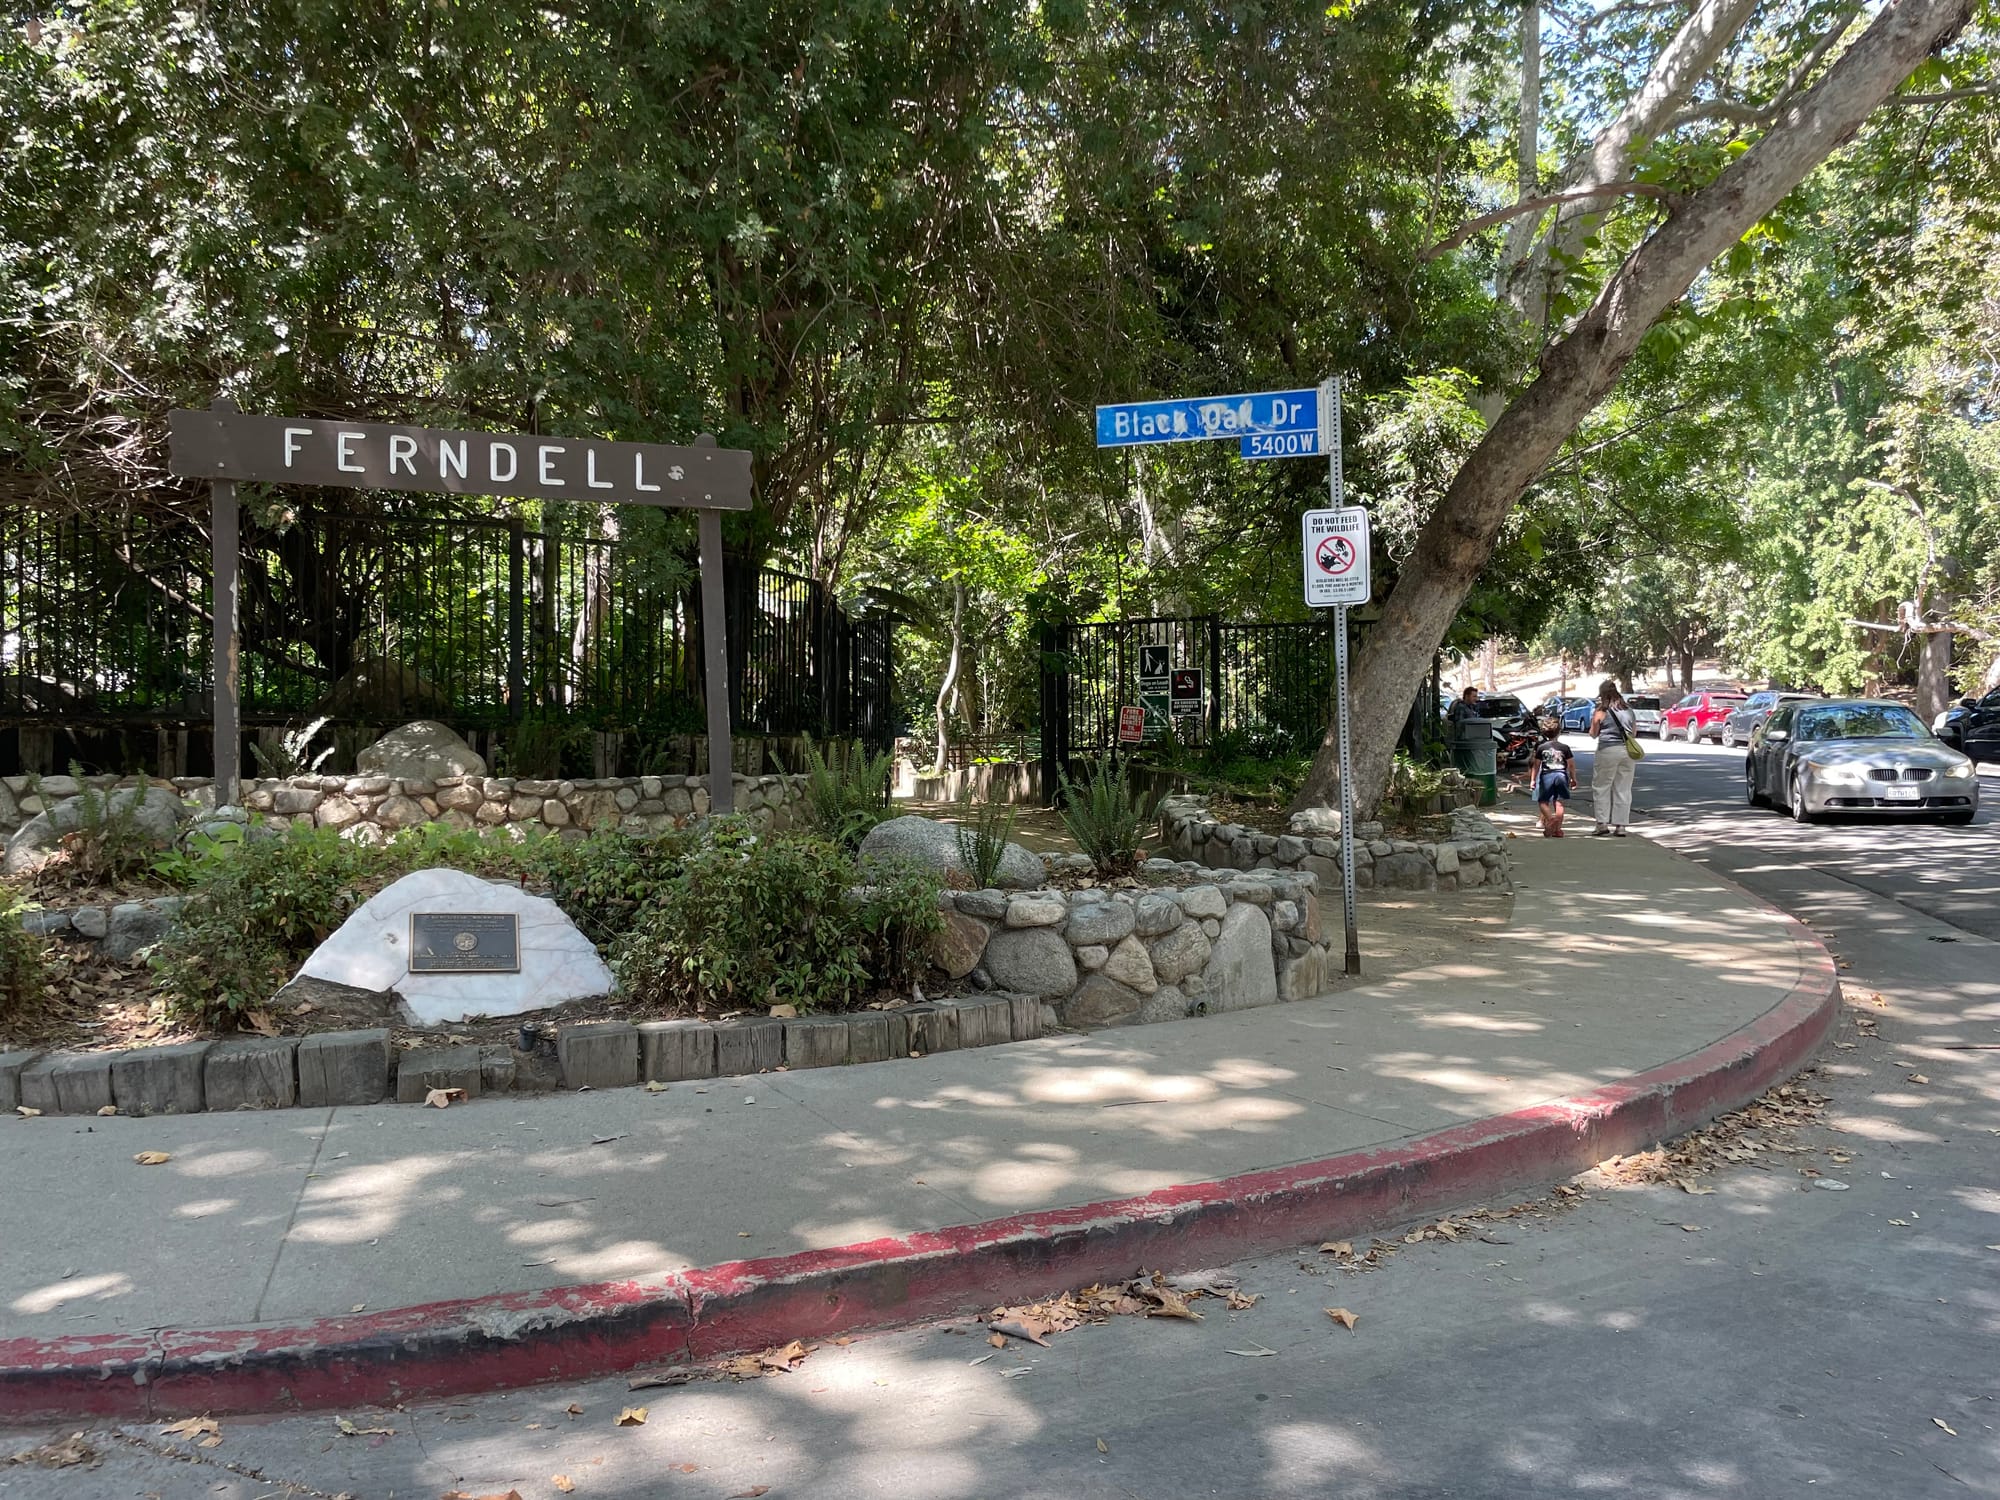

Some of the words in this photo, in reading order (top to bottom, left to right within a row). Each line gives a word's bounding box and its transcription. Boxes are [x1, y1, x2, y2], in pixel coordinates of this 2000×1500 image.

[1115, 409, 1189, 438] Black
[1203, 400, 1253, 431] Oak
[1271, 399, 1303, 426] Dr
[284, 427, 661, 492] FERNDELL
[1311, 525, 1325, 534] THE
[1326, 523, 1360, 533] WILDLIFE
[1324, 517, 1339, 525] NOT
[1340, 515, 1358, 524] FEED
